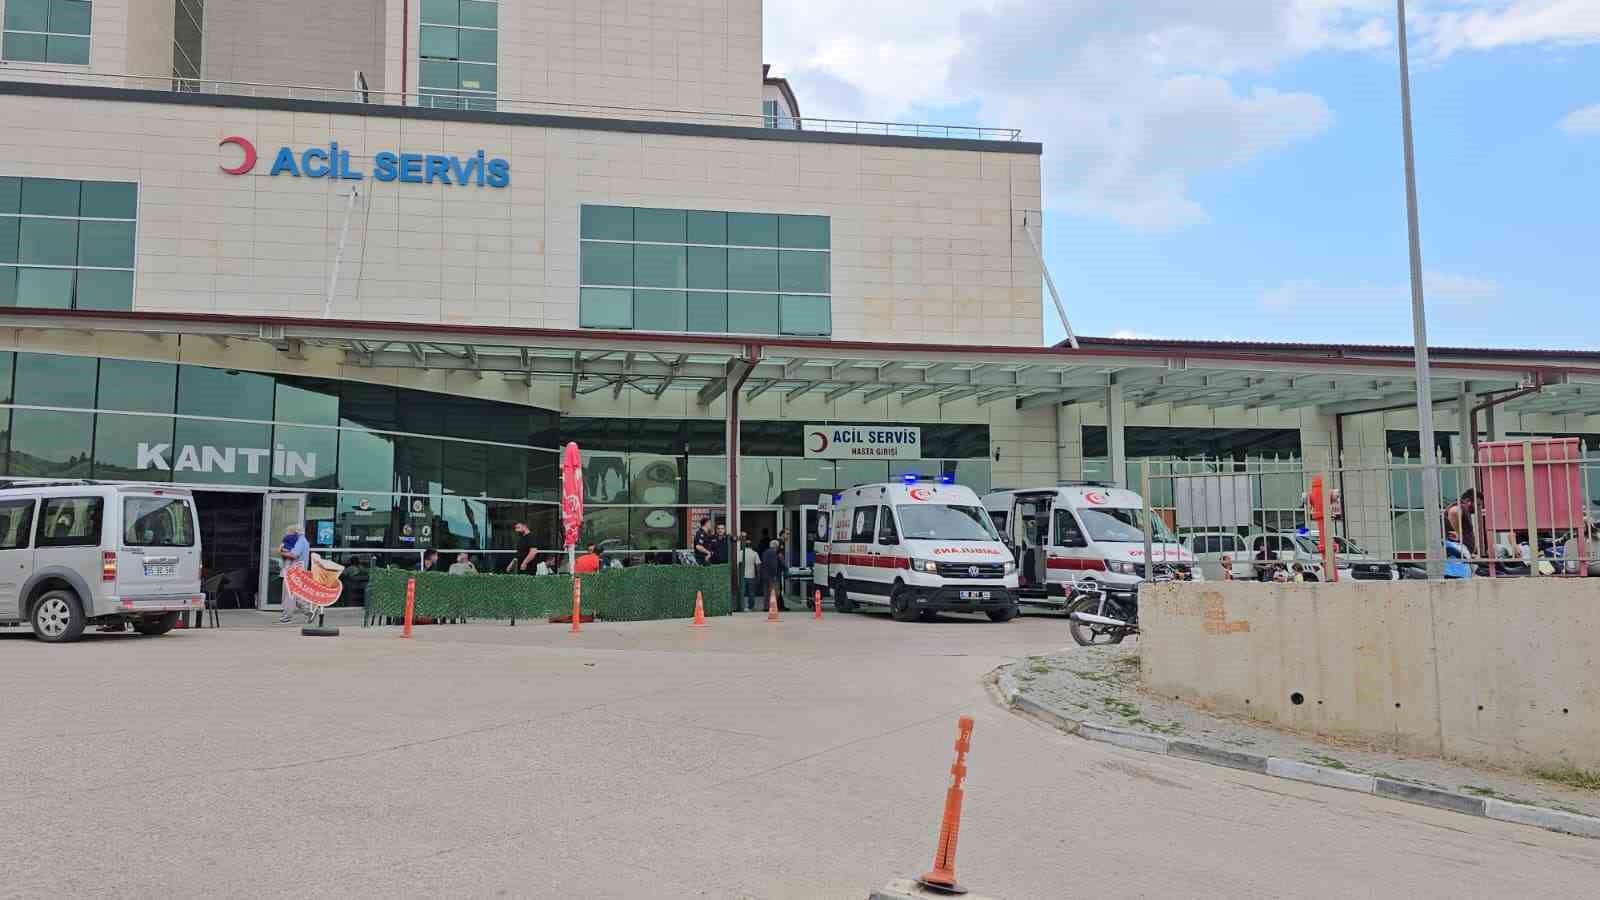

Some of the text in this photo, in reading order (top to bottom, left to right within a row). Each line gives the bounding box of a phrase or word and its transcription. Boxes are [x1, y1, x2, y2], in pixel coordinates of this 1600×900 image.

[270, 141, 510, 188] ACİL SERVİS
[833, 428, 916, 444] ACİL SERVİS
[136, 442, 317, 478] KANTİN
[851, 447, 874, 456] HASTA
